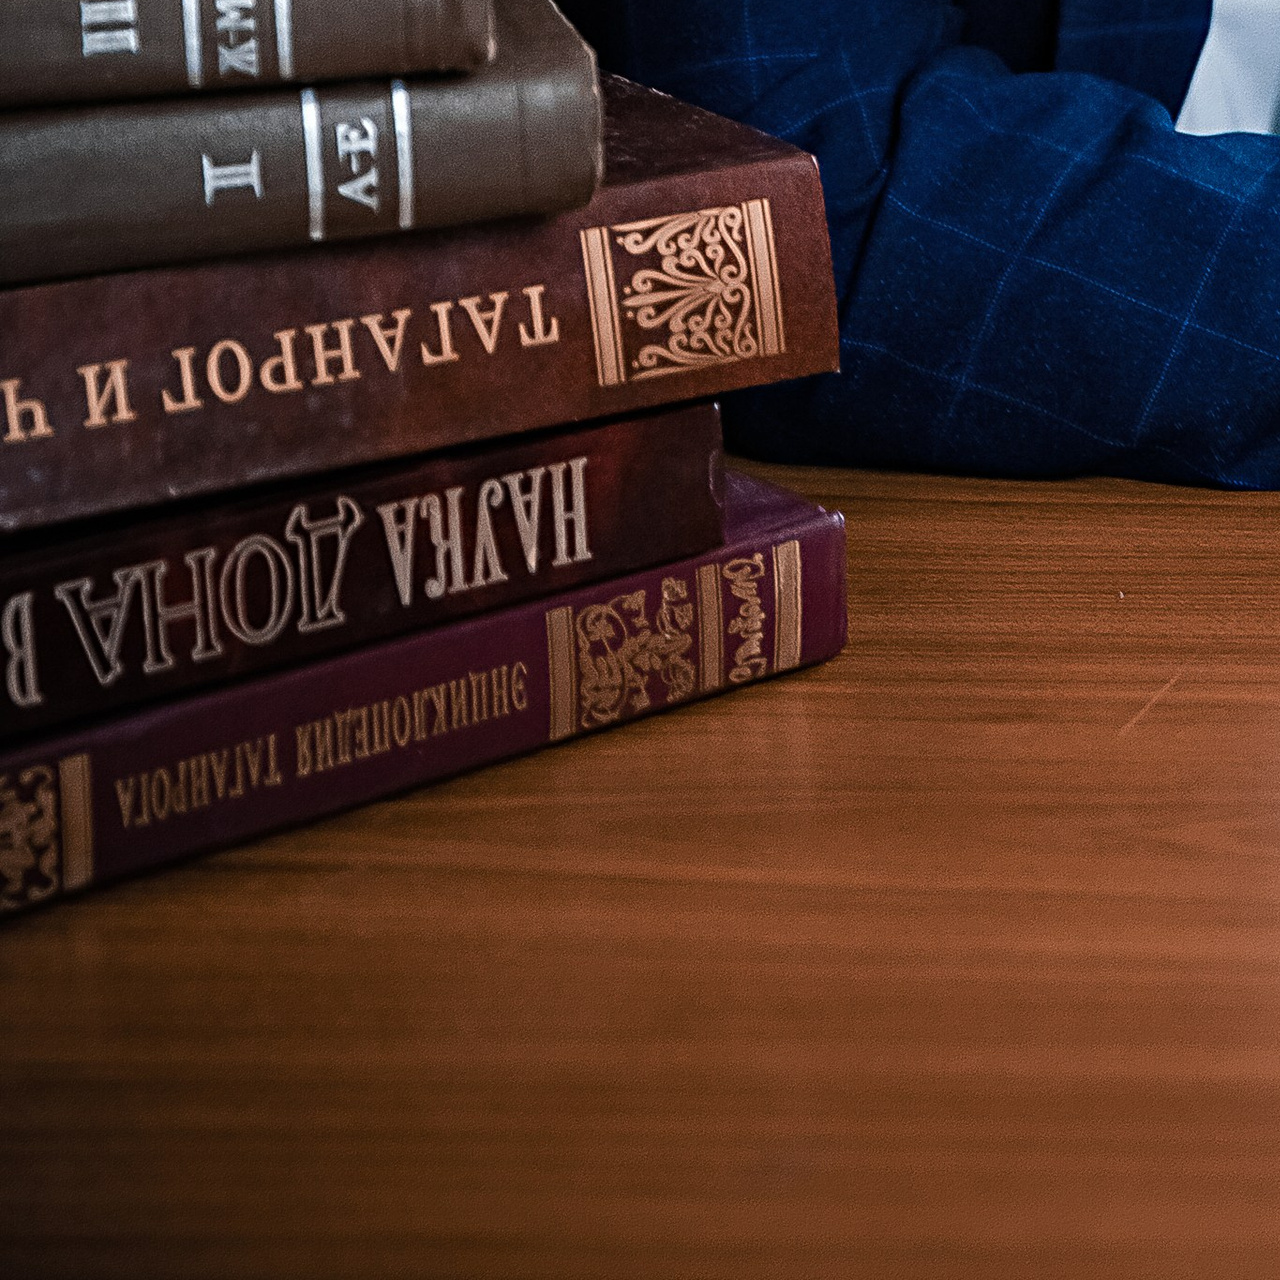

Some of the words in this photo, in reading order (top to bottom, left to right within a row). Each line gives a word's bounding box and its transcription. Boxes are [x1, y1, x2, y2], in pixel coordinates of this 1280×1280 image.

[201, 149, 265, 208] I
[336, 116, 381, 214] А-Е
[76, 358, 138, 429] И
[161, 284, 560, 413] ТАГАНРОГ
[376, 455, 594, 606] НАУКА
[0, 589, 45, 709] В
[54, 494, 365, 688] ДОНА
[295, 660, 530, 779] ЭНЦИКЛОПЕДИЯ
[114, 731, 284, 829] ТАГАНРОГА
